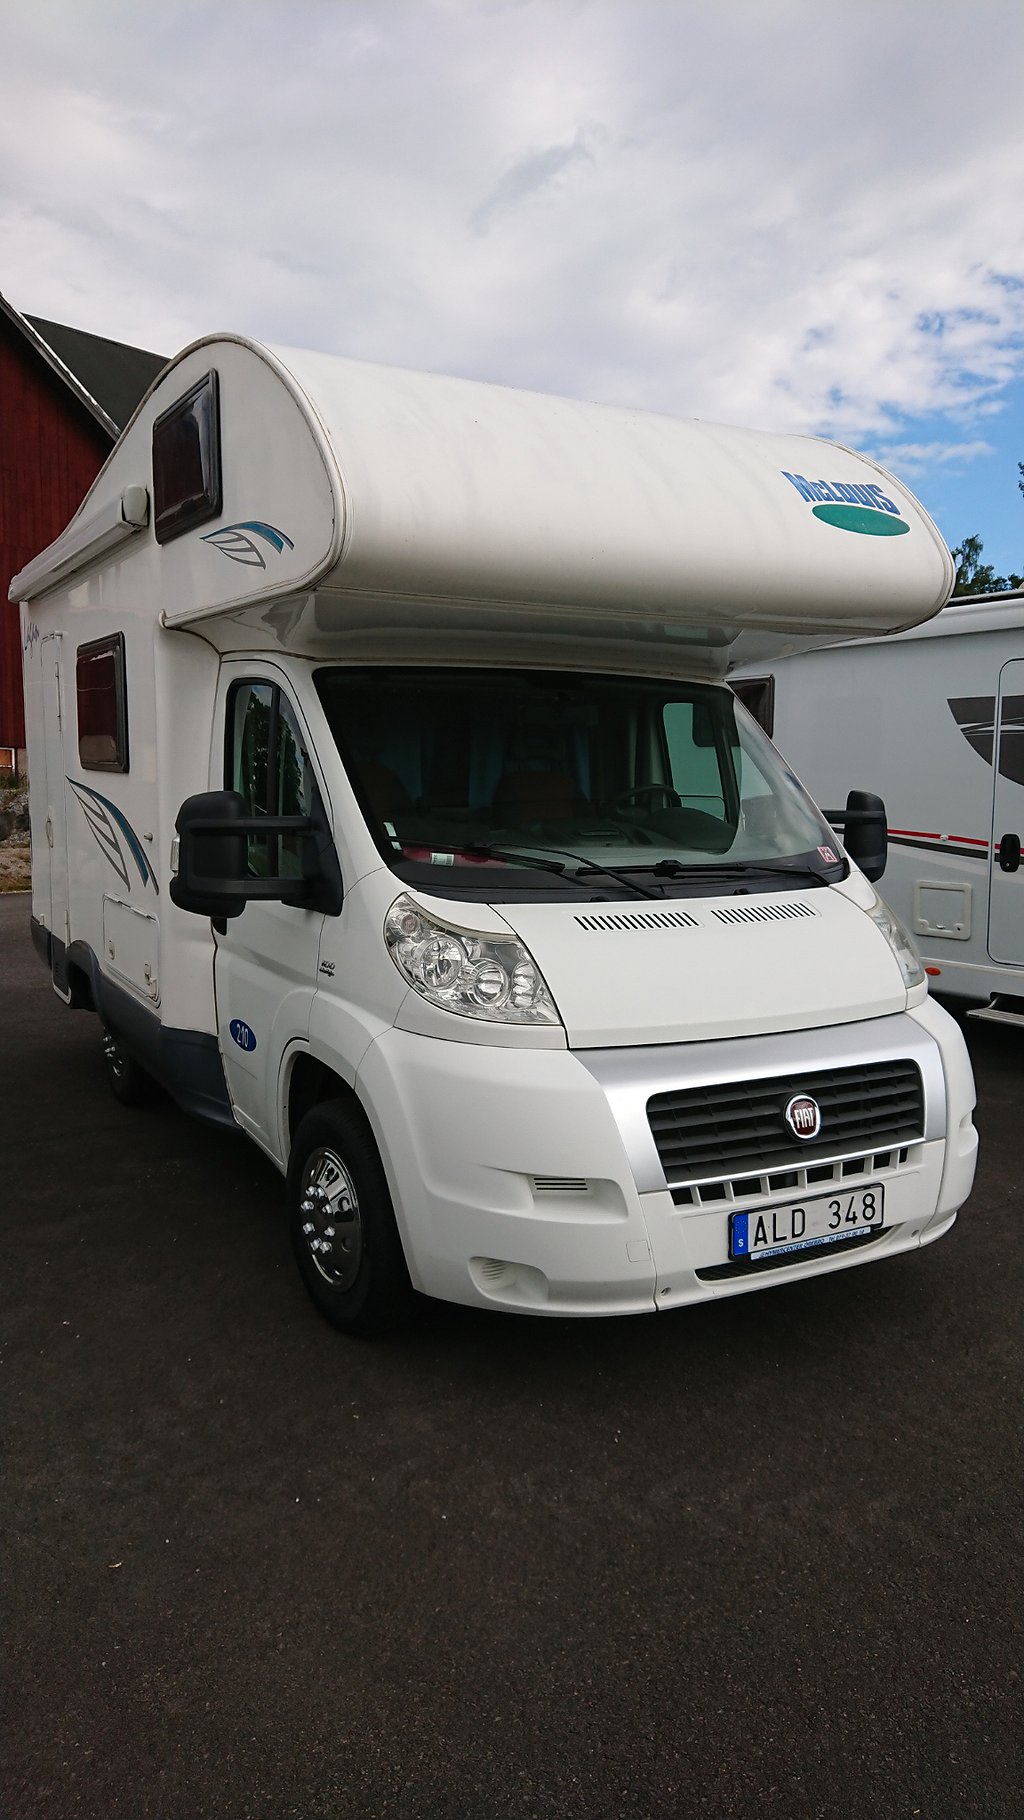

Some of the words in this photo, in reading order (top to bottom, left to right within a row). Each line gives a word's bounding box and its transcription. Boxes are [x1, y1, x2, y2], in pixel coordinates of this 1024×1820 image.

[236, 1023, 249, 1048] 210
[794, 1107, 814, 1129] FIAT
[754, 1208, 806, 1247] ALD
[828, 1193, 876, 1229] 348
[738, 1238, 744, 1248] S
